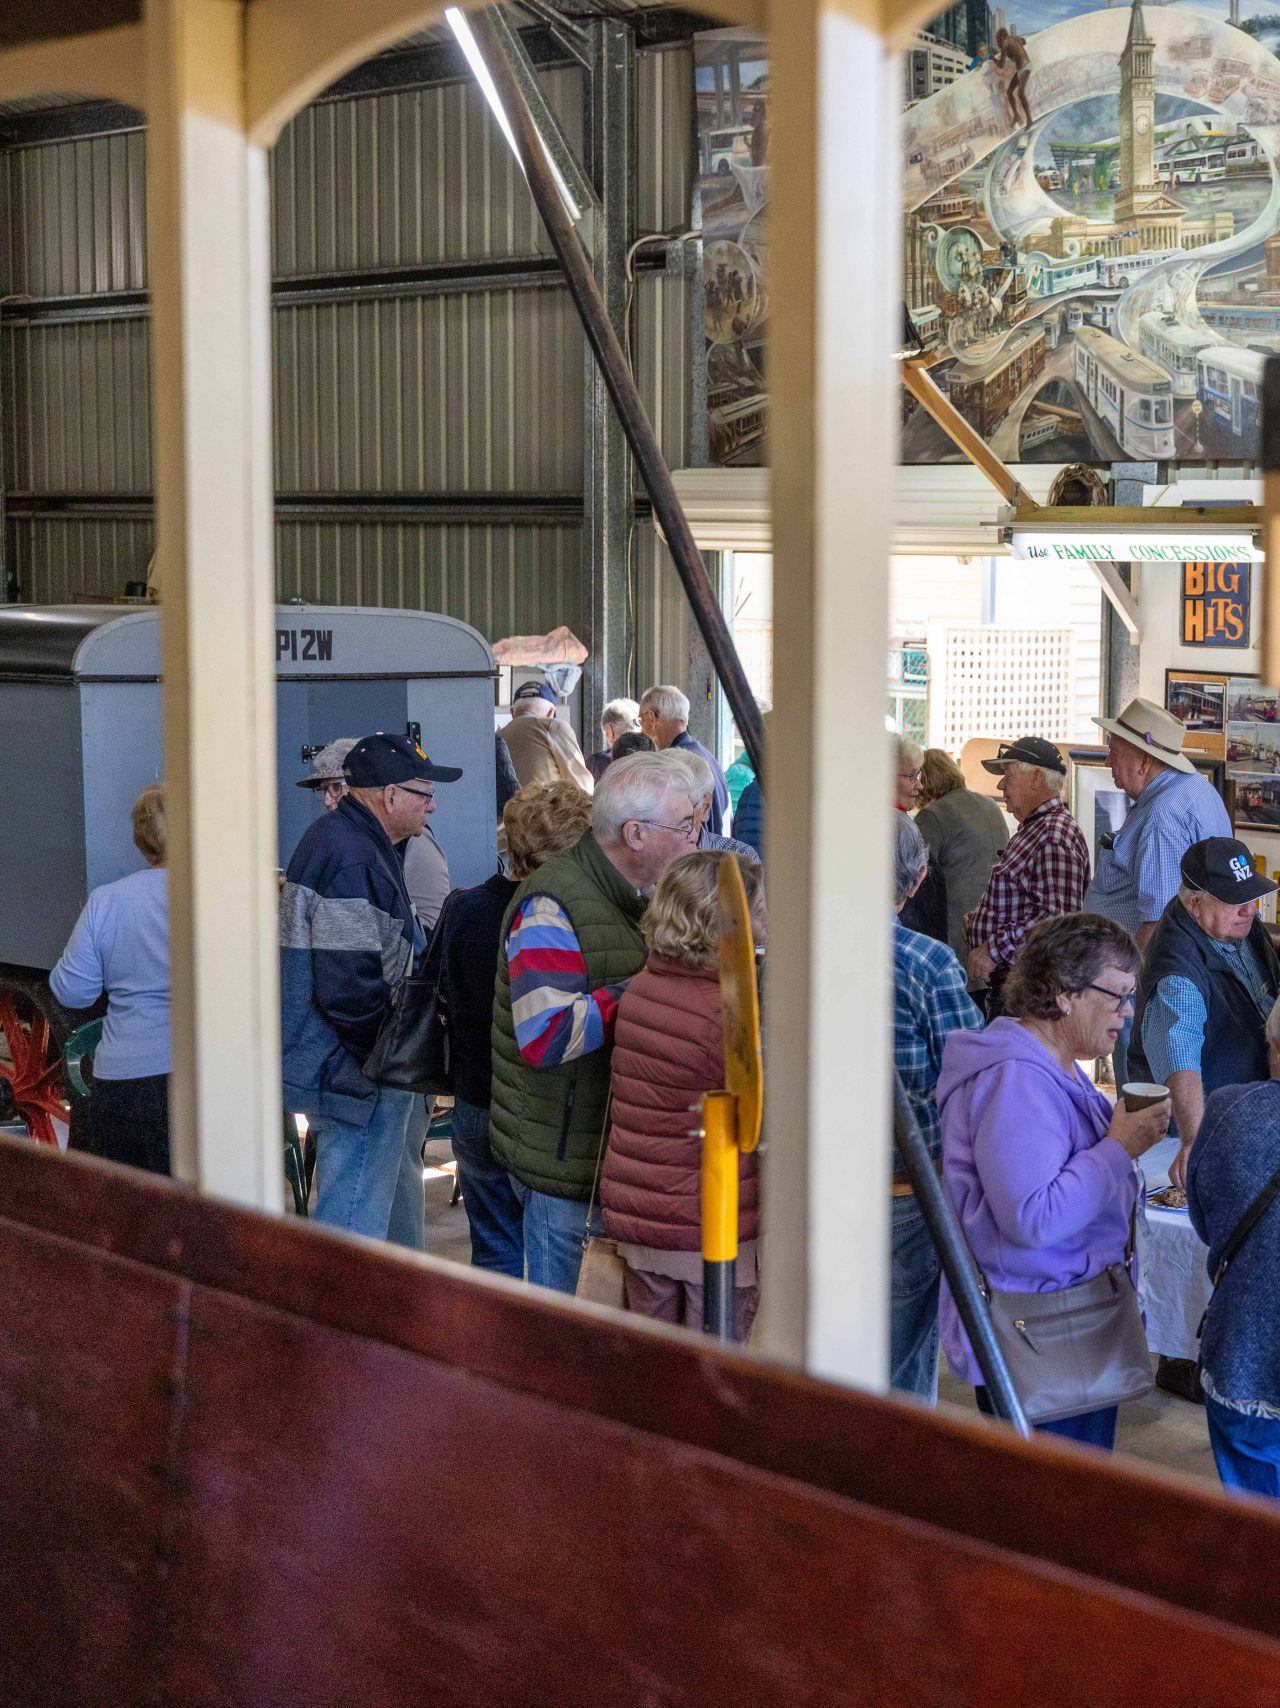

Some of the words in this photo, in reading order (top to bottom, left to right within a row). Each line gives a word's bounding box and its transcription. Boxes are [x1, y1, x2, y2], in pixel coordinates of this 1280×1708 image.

[1028, 546, 1049, 558] Use
[1052, 545, 1116, 560] FAMILY
[1130, 546, 1252, 561] CONCESSIONS
[1185, 561, 1240, 596] BIG
[1184, 598, 1244, 642] HITS
[1233, 865, 1253, 882] NZ
